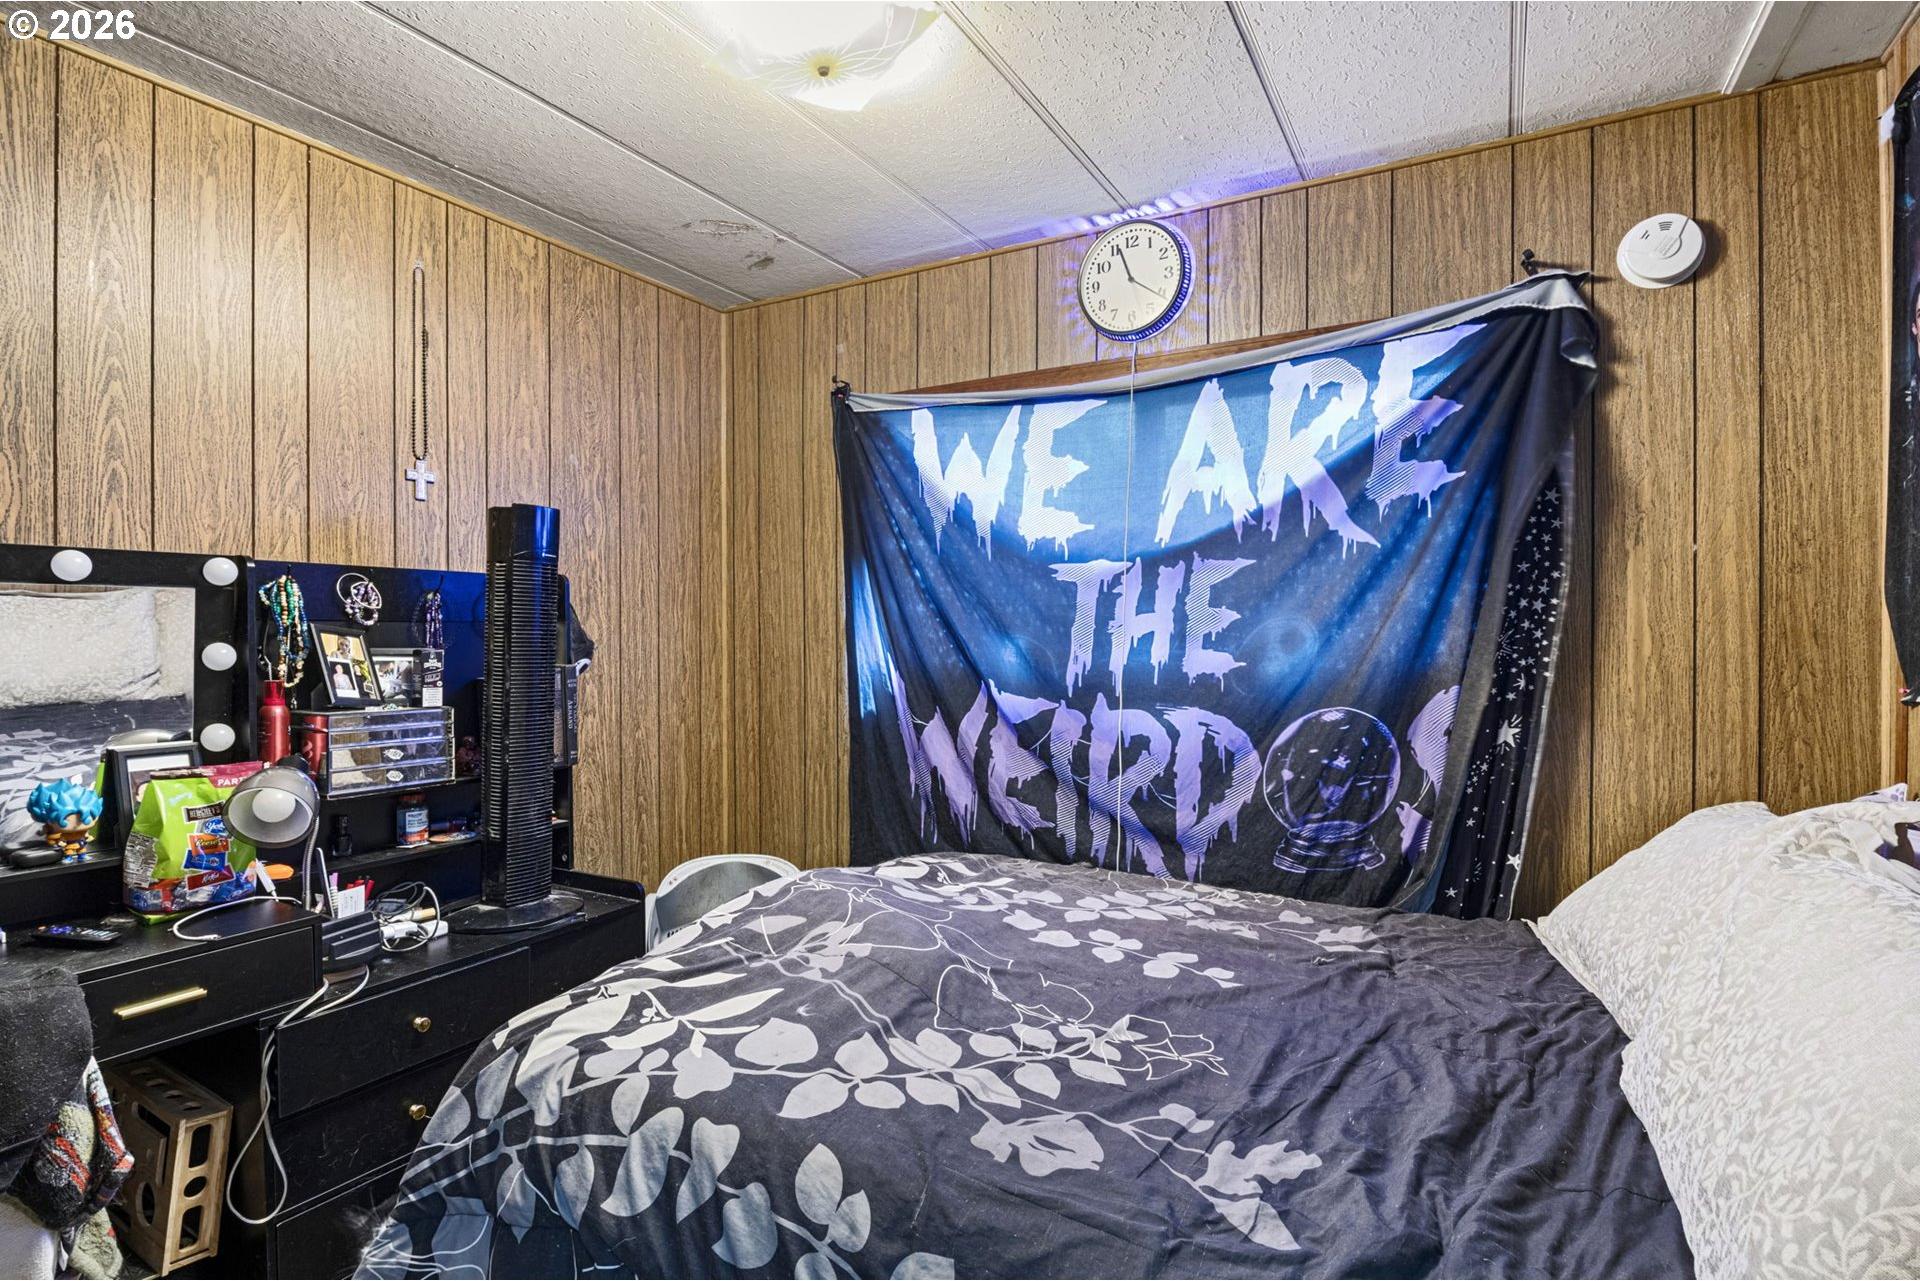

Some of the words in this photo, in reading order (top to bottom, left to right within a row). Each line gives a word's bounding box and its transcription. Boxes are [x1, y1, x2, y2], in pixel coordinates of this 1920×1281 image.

[1125, 235, 1139, 249] 12
[1147, 237, 1152, 248] 1
[1159, 247, 1168, 260] 2
[1097, 261, 1111, 274] 10
[1164, 266, 1174, 279] 3
[1092, 281, 1100, 293] 9
[1099, 299, 1106, 312] 8
[1111, 308, 1119, 321] 7
[1128, 310, 1136, 323] 6
[911, 398, 1108, 560] WE
[1155, 323, 1488, 558] ARE
[1049, 552, 1257, 697] THE
